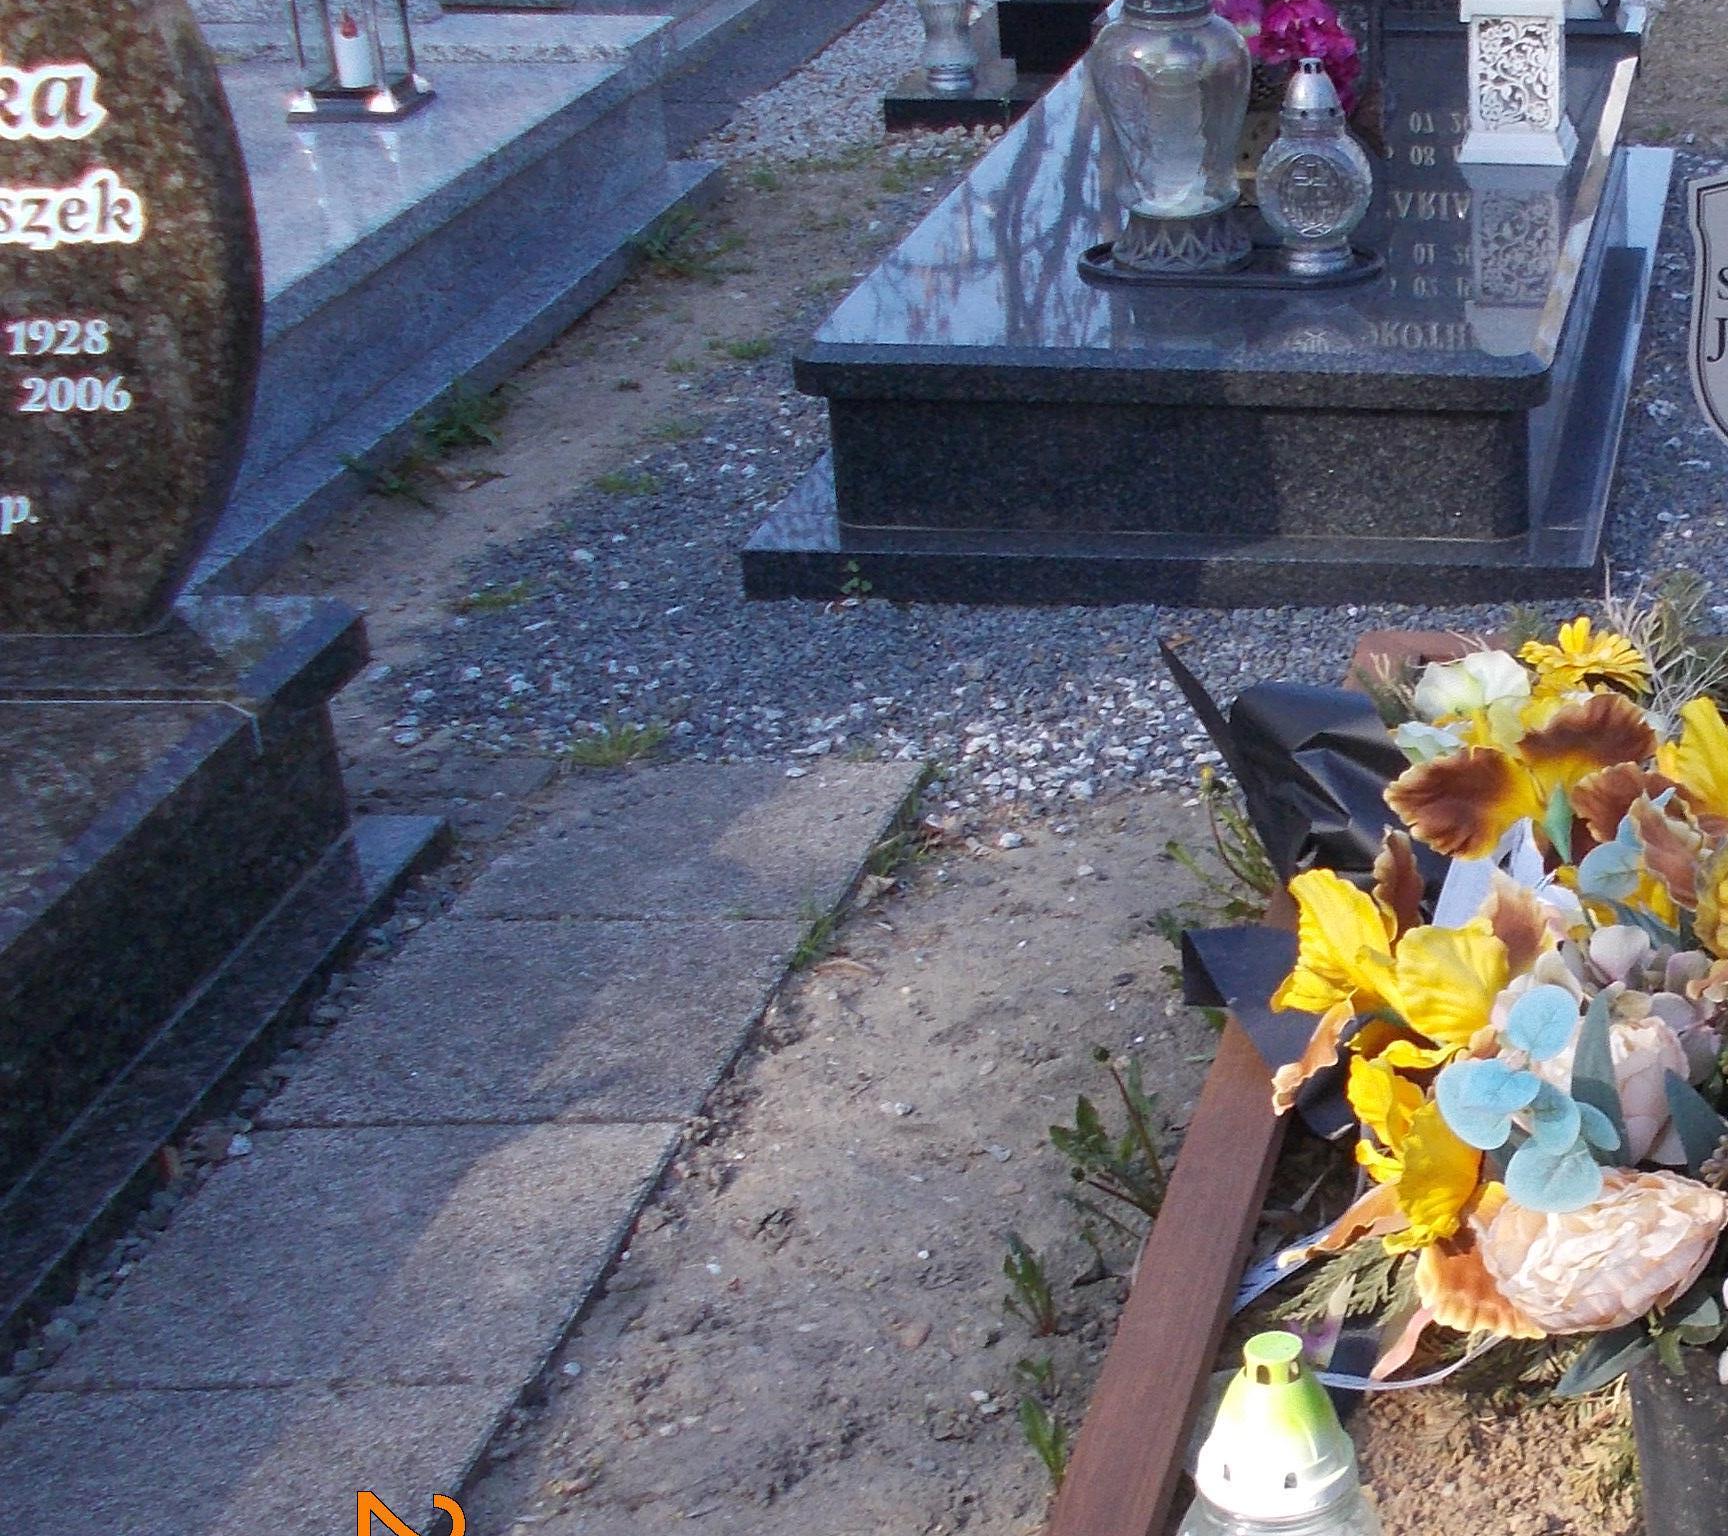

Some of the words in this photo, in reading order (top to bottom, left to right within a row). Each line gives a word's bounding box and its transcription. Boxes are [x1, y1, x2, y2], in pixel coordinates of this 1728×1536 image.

[0, 170, 142, 244] szek
[7, 319, 111, 356] 1928
[19, 375, 133, 413] 2006
